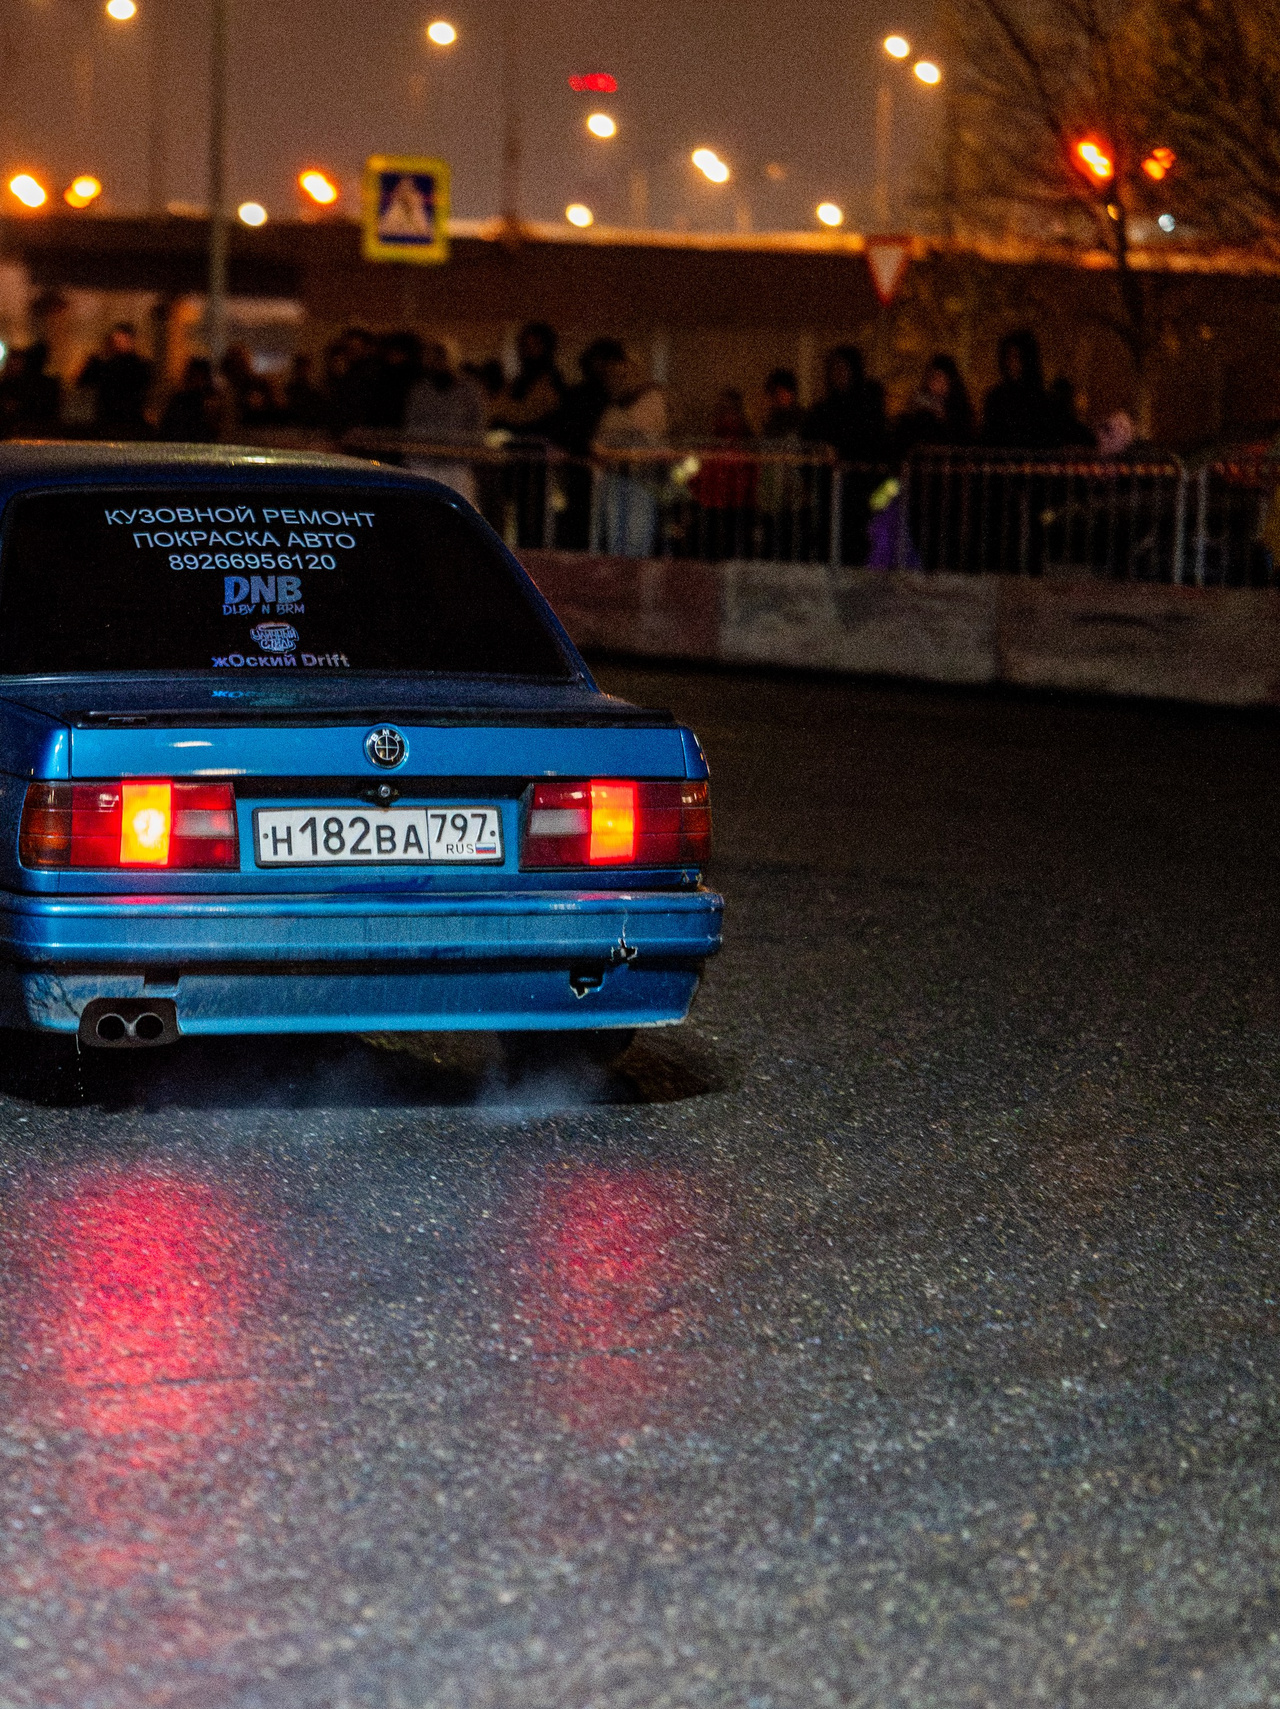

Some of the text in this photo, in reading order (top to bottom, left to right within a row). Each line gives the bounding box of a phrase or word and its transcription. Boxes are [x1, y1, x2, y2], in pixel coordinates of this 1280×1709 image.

[104, 505, 376, 528] КУЗОВНОЙ РЕМОНТ
[133, 530, 356, 549] ПОКРАСКА АВТО
[169, 553, 337, 571] 89266956120
[223, 575, 303, 605] DNB
[261, 604, 271, 615] N
[276, 602, 305, 616] BRM
[301, 652, 351, 668] Drift
[430, 813, 488, 843] 797
[446, 843, 475, 855] RUS
